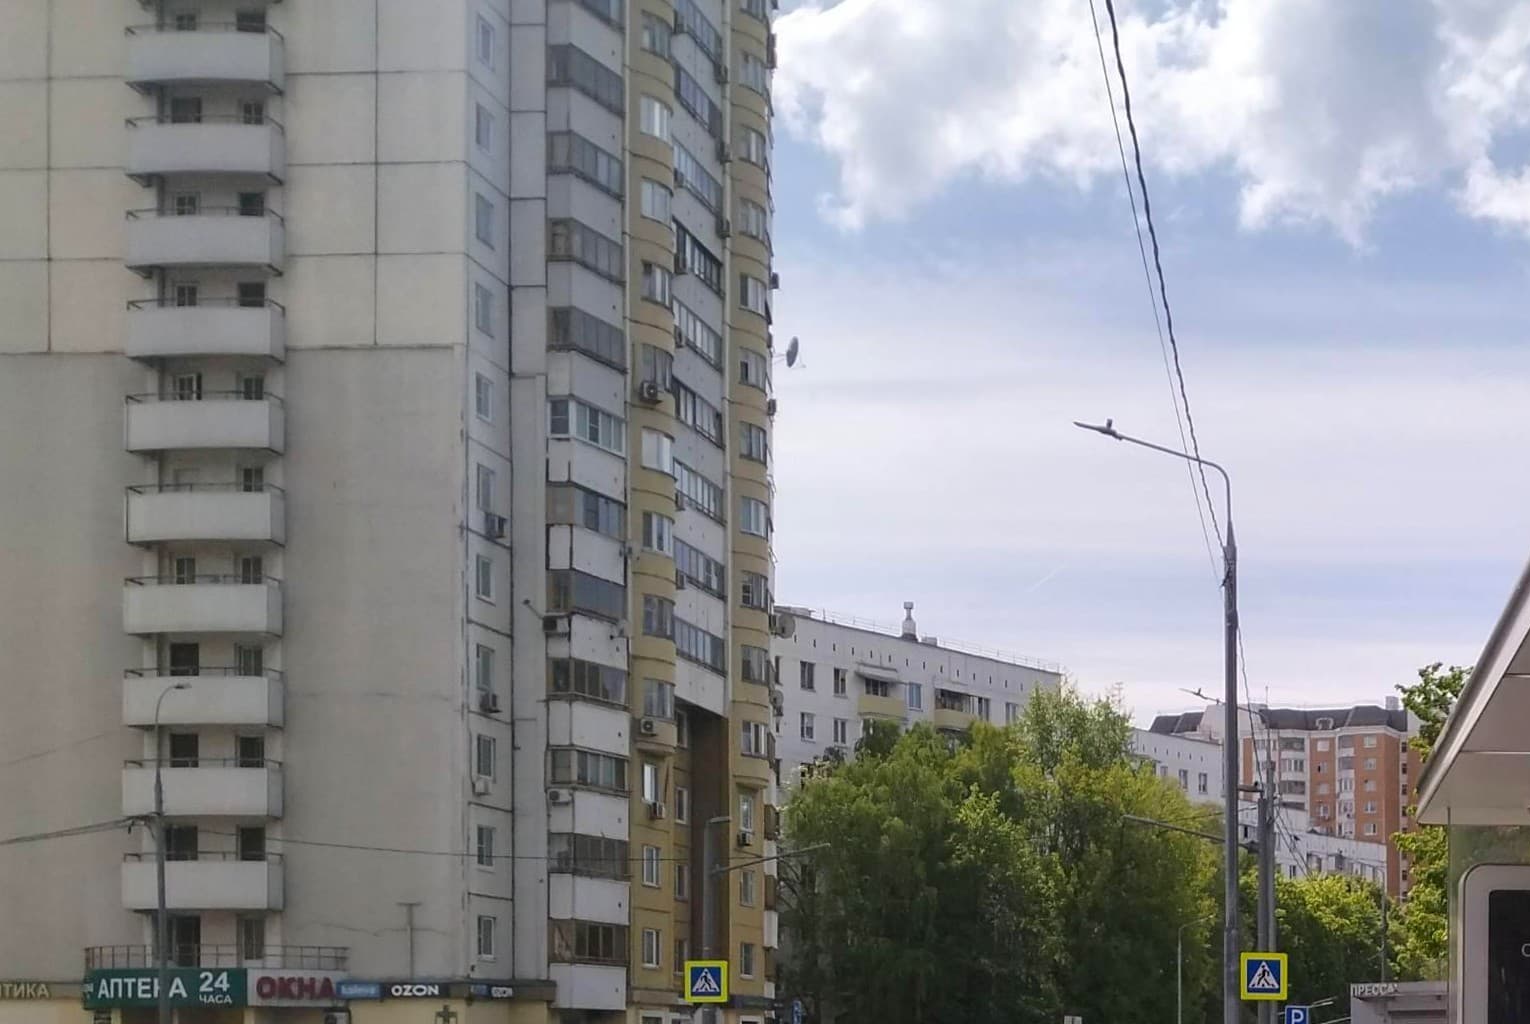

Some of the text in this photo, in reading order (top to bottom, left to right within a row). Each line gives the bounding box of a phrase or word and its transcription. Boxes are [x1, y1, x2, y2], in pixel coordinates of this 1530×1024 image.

[199, 971, 230, 993] 24
[256, 976, 337, 1000] ОКНА
[0, 983, 49, 998] ТИКА
[391, 984, 440, 997] OZON
[199, 994, 232, 1005] ЧАСА
